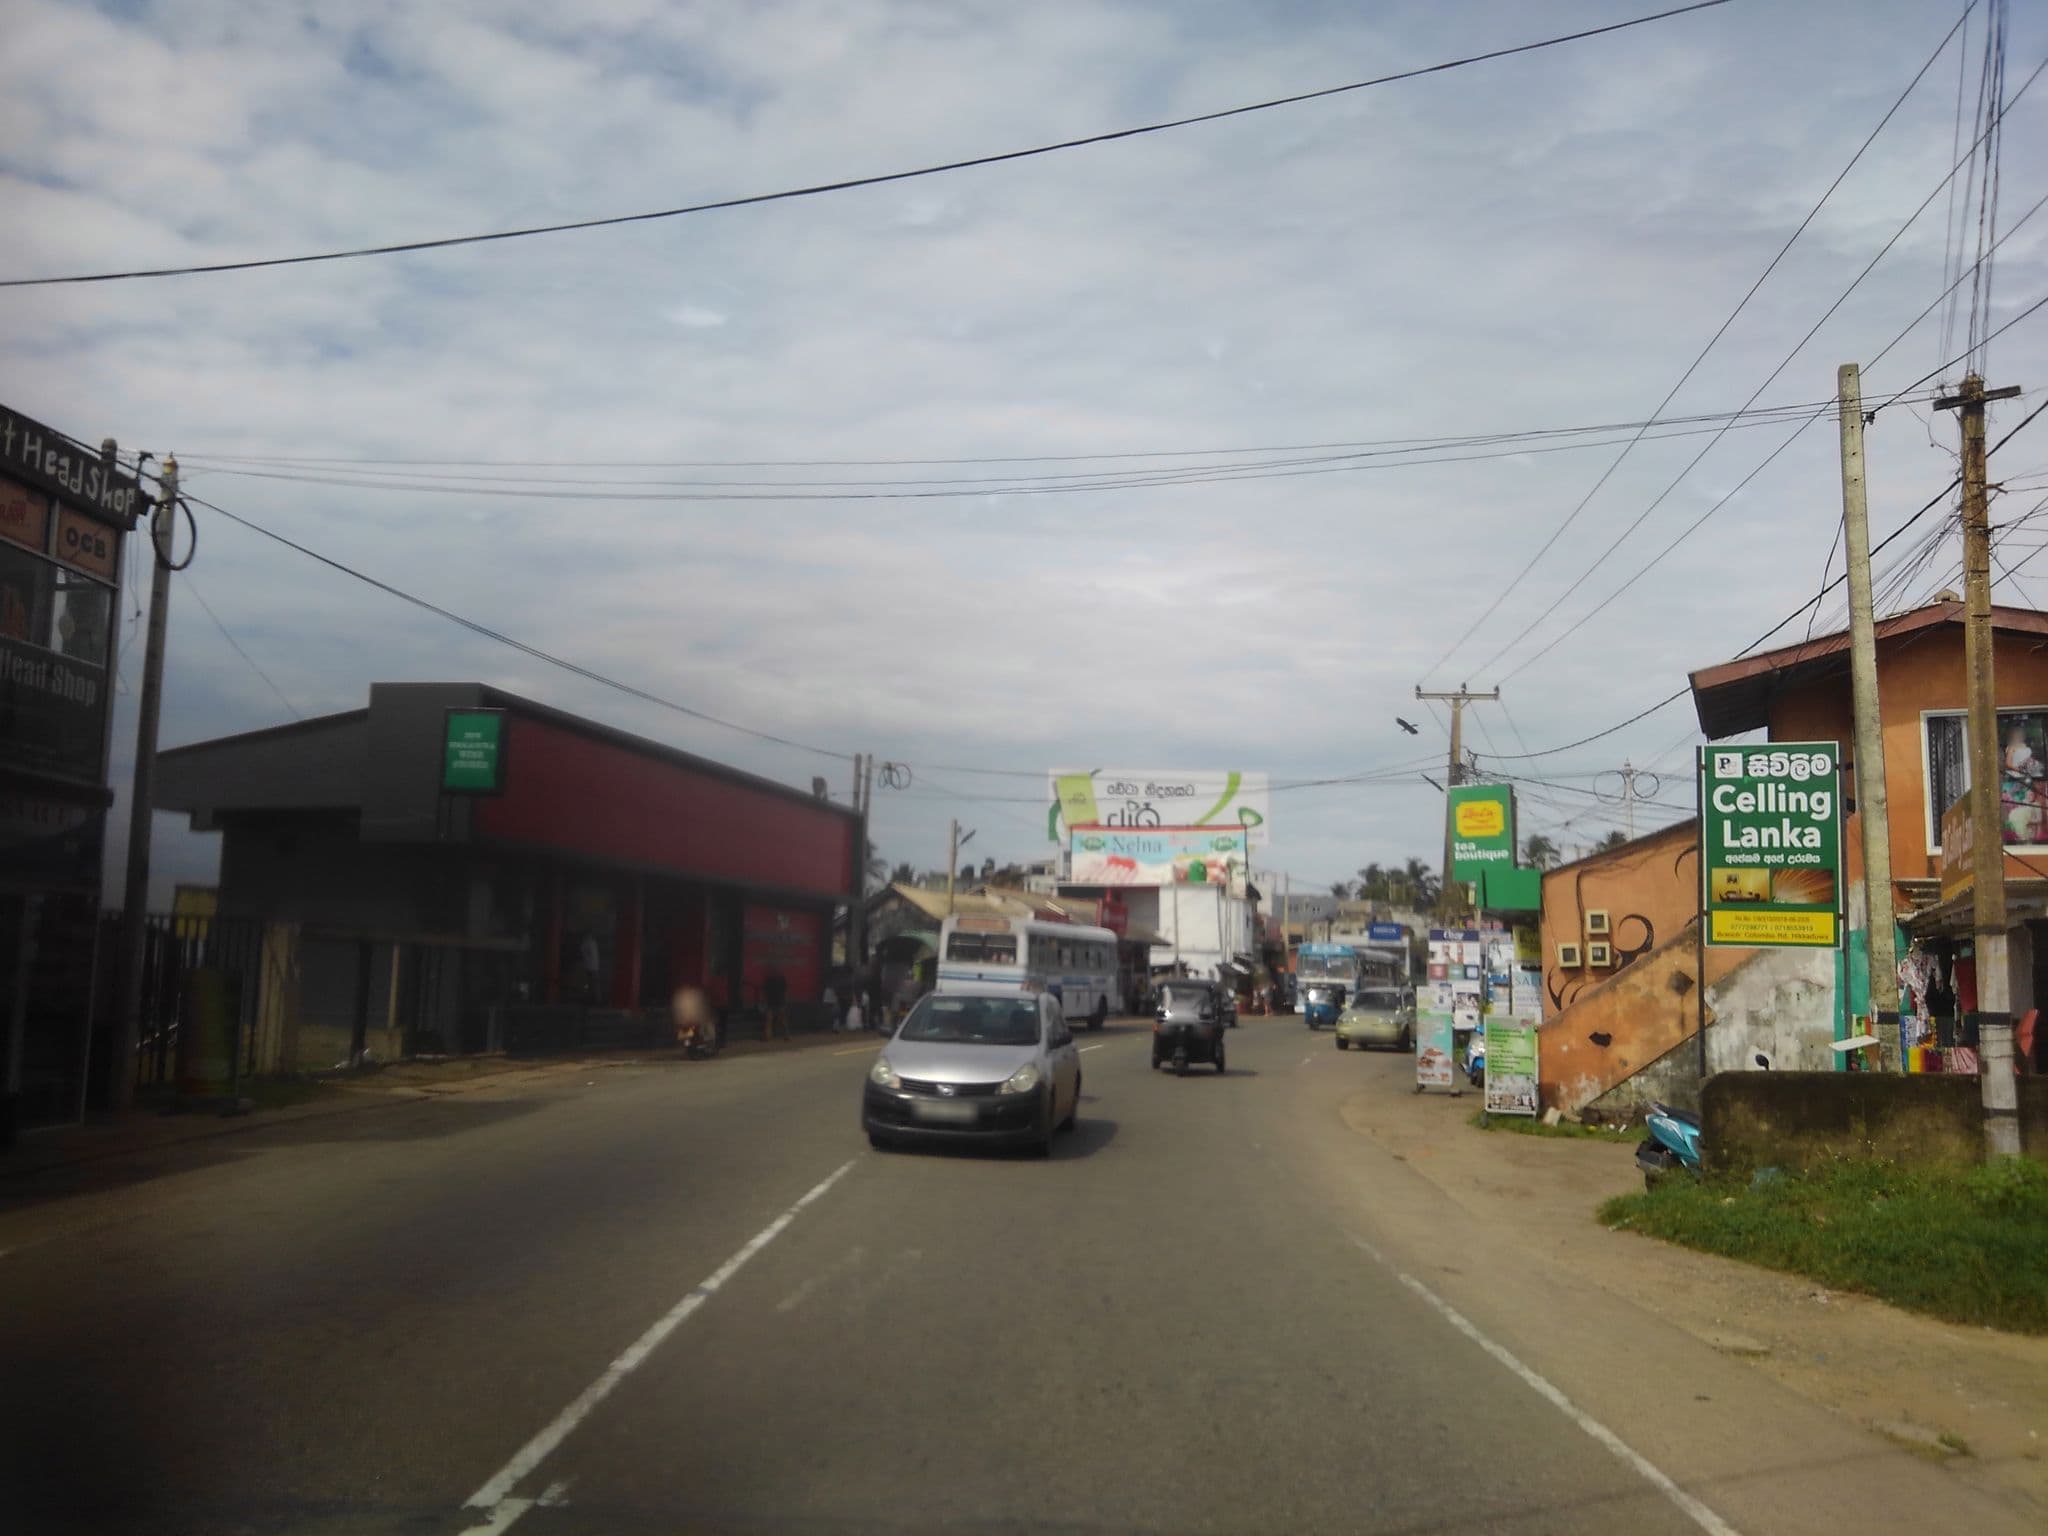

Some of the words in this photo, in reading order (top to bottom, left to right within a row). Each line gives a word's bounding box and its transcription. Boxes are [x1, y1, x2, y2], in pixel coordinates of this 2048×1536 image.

[22, 430, 84, 495] Head
[66, 527, 106, 560] OCB
[52, 664, 97, 708] Shop
[1712, 783, 1831, 820] Celling
[1112, 835, 1162, 854] Nelna
[1454, 842, 1476, 851] tea
[1723, 818, 1821, 848] Lanka
[1454, 849, 1509, 861] boutique
